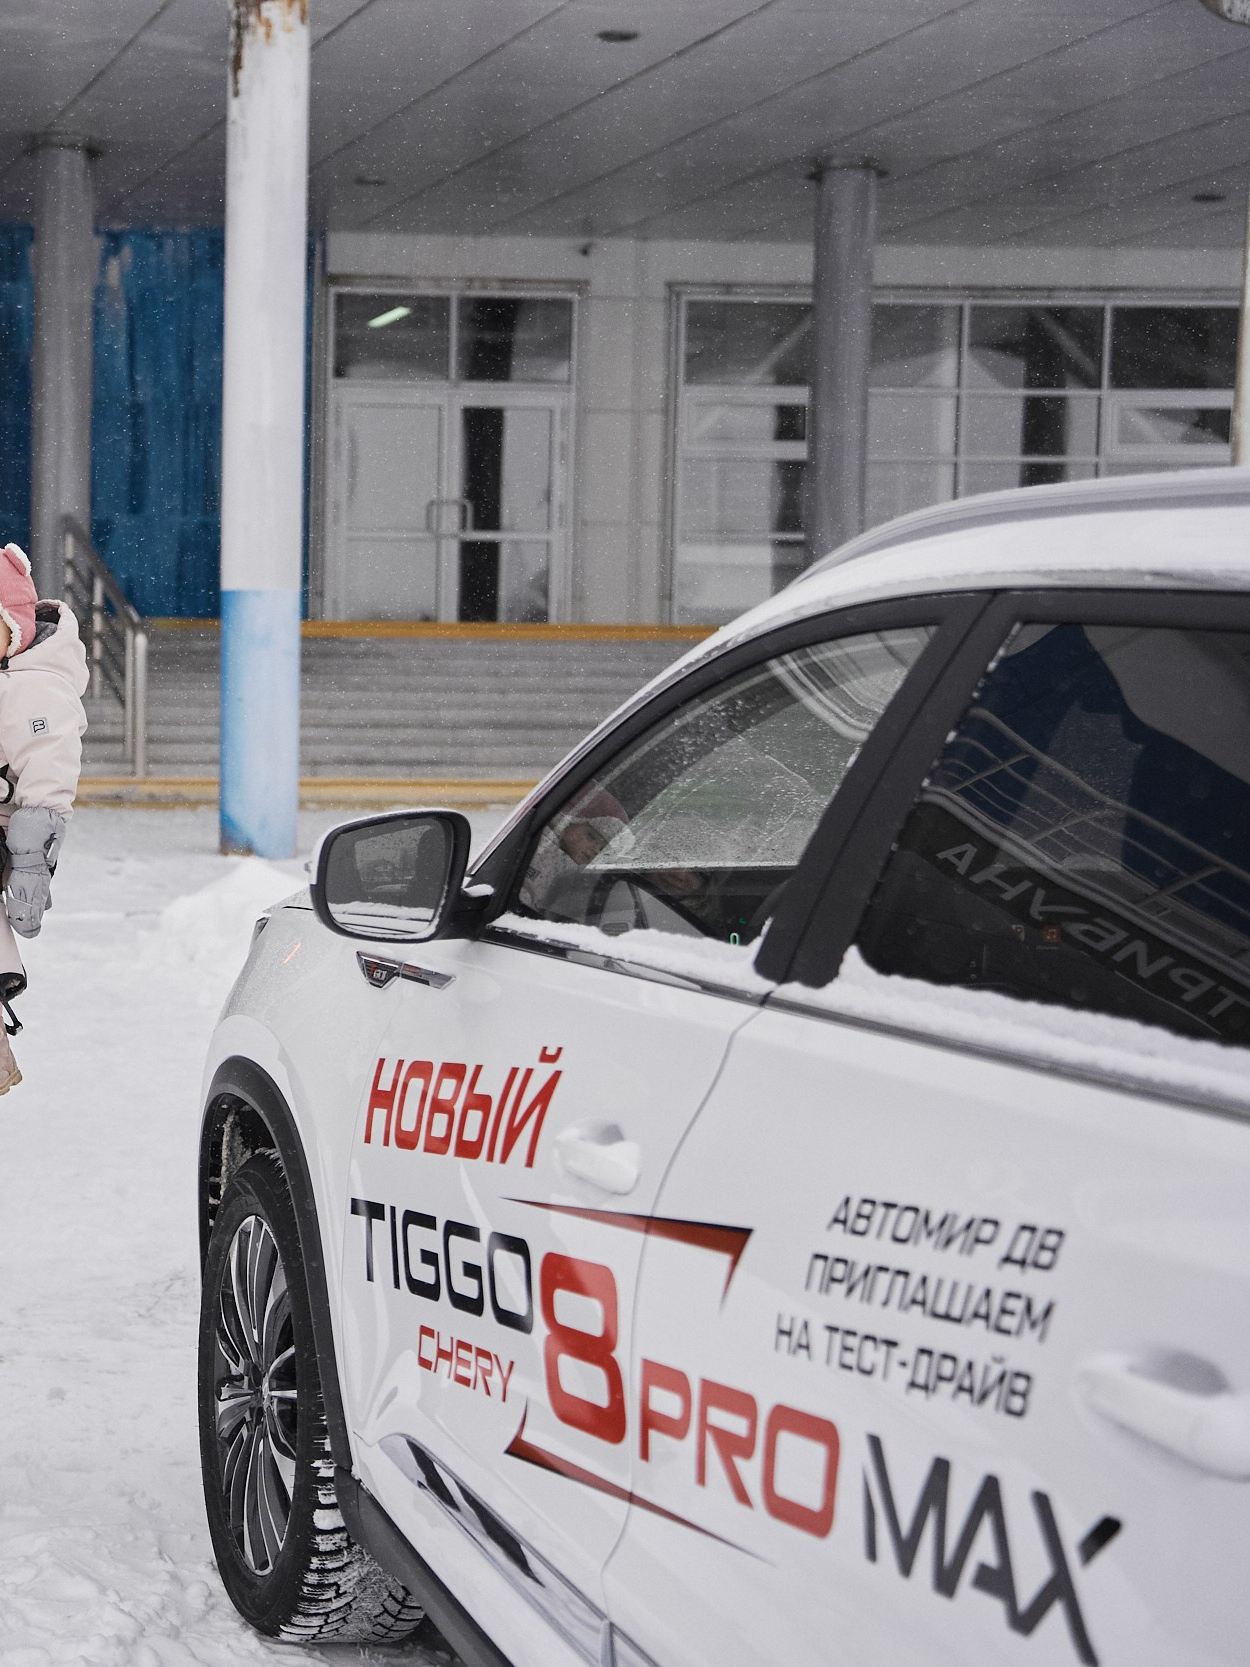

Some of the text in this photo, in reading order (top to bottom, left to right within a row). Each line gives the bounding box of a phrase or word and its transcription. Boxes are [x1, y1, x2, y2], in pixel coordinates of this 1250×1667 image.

[363, 1046, 563, 1169] НОВЫЙ
[826, 1196, 1066, 1274] АВТОМИР ДВ
[805, 1252, 1056, 1343] ПРИГЛАШАЕМ
[417, 1325, 515, 1403] CHERY
[775, 1314, 1033, 1419] НА ТЕСТ-ДРАЙВ
[350, 1197, 1124, 1667] TIGGO 8 PRO MAX
